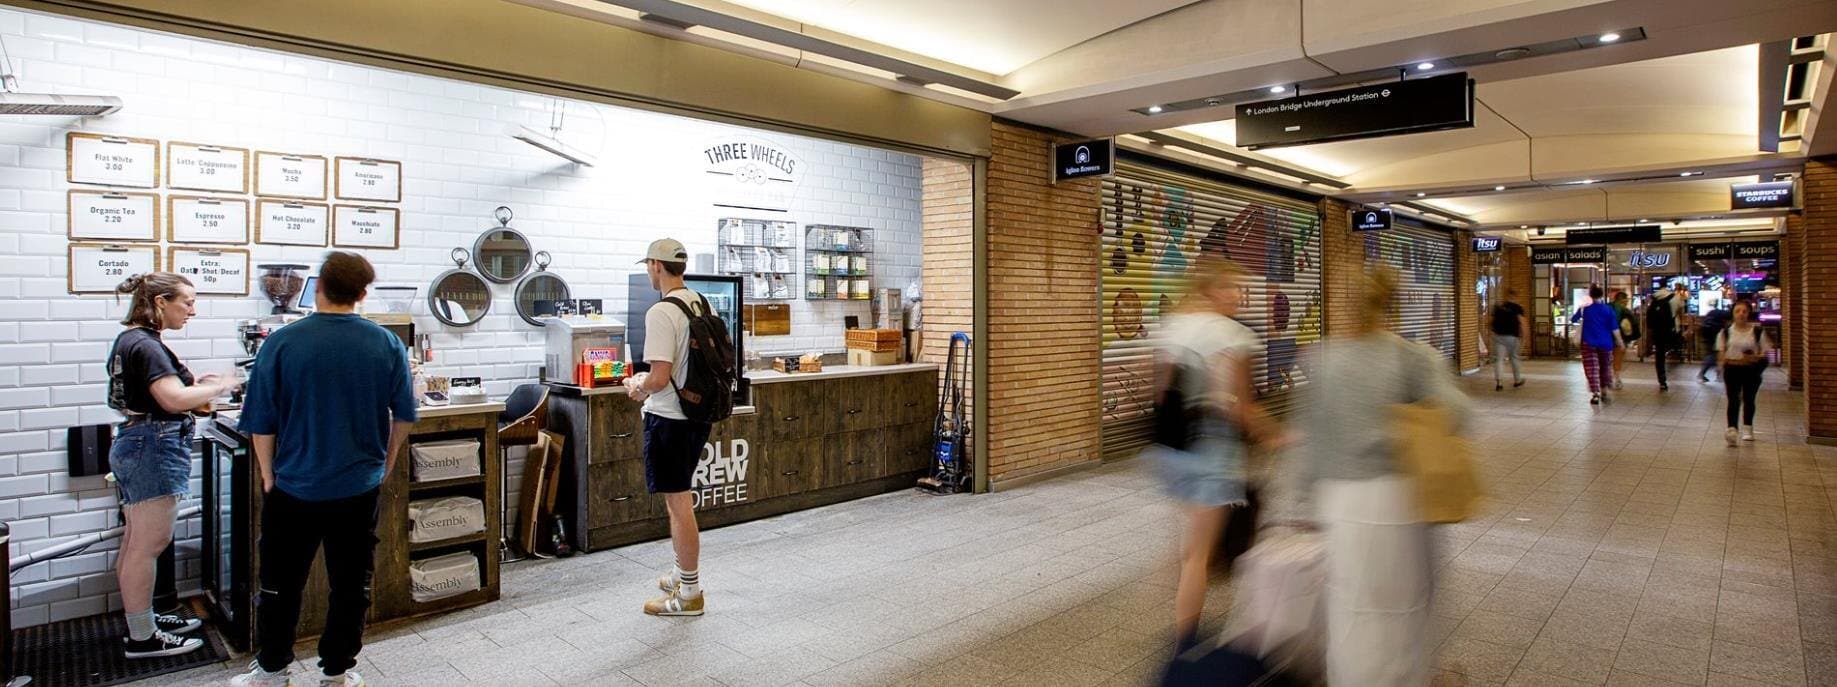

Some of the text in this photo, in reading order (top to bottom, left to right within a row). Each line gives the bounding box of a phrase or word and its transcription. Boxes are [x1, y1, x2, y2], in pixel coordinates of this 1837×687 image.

[1253, 91, 1379, 115] London Bridge Underground Station
[95, 153, 133, 163] Flat White
[704, 143, 795, 175] THREE WHEELS
[1736, 189, 1789, 198] STARBUCKS
[90, 207, 136, 216] Organic Tea
[195, 212, 225, 220] Espresso
[285, 216, 316, 224] Chocolate
[1477, 238, 1498, 248] itsu
[1695, 245, 1775, 256] sushi soups
[1534, 251, 1600, 261] asian salads
[1629, 250, 1670, 267] itsu
[98, 260, 129, 268] Cortado
[105, 268, 122, 276] 2.80
[203, 275, 217, 284] 50p
[697, 438, 749, 468] OLD
[690, 459, 749, 488] REW
[690, 483, 748, 509] OFFEE
